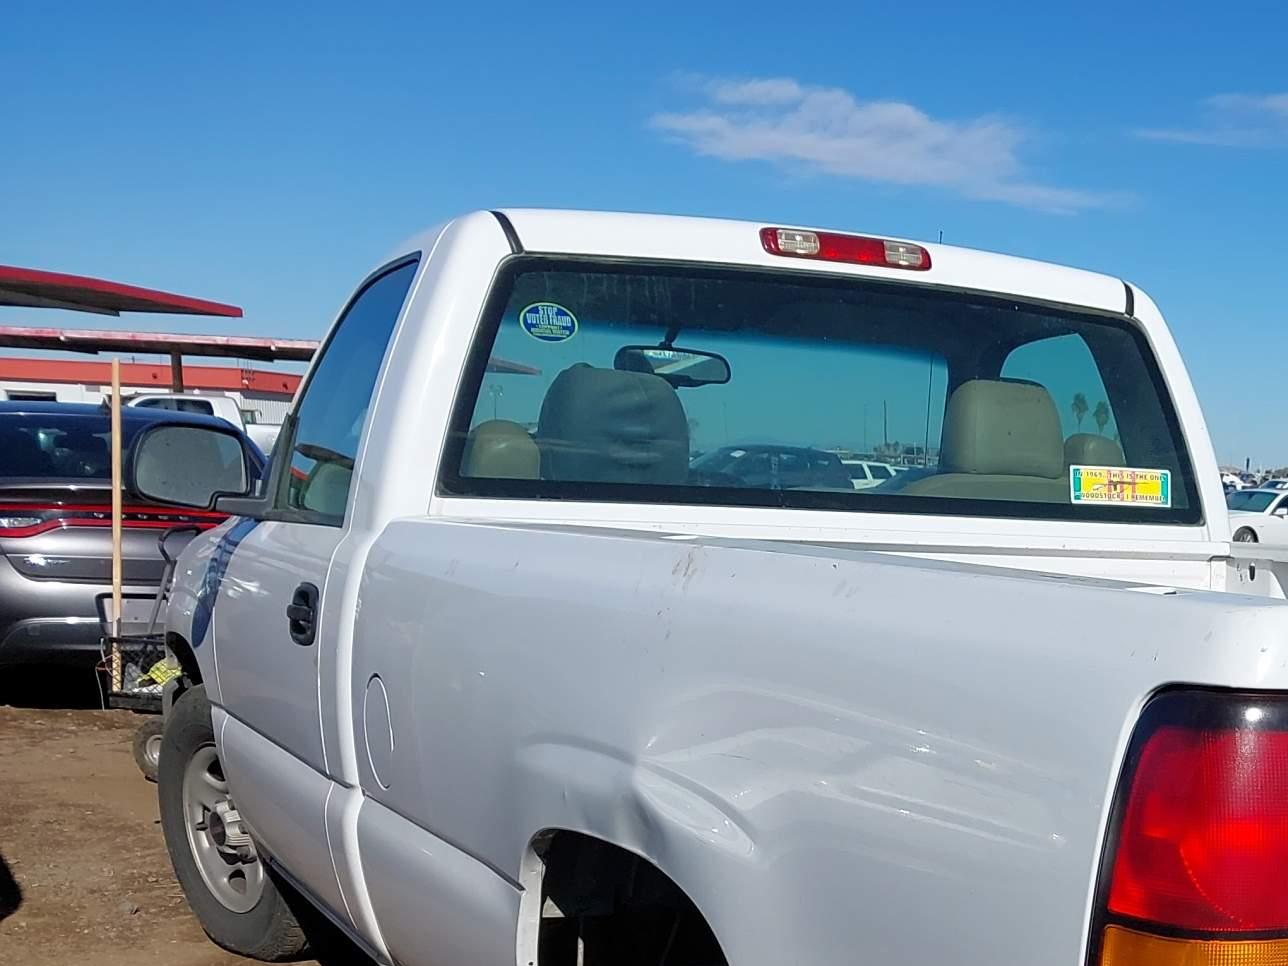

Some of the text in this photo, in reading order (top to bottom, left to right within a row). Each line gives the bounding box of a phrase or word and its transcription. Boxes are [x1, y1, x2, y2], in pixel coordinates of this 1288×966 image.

[538, 306, 558, 317] STOP
[526, 313, 572, 326] VOTER FRAUD
